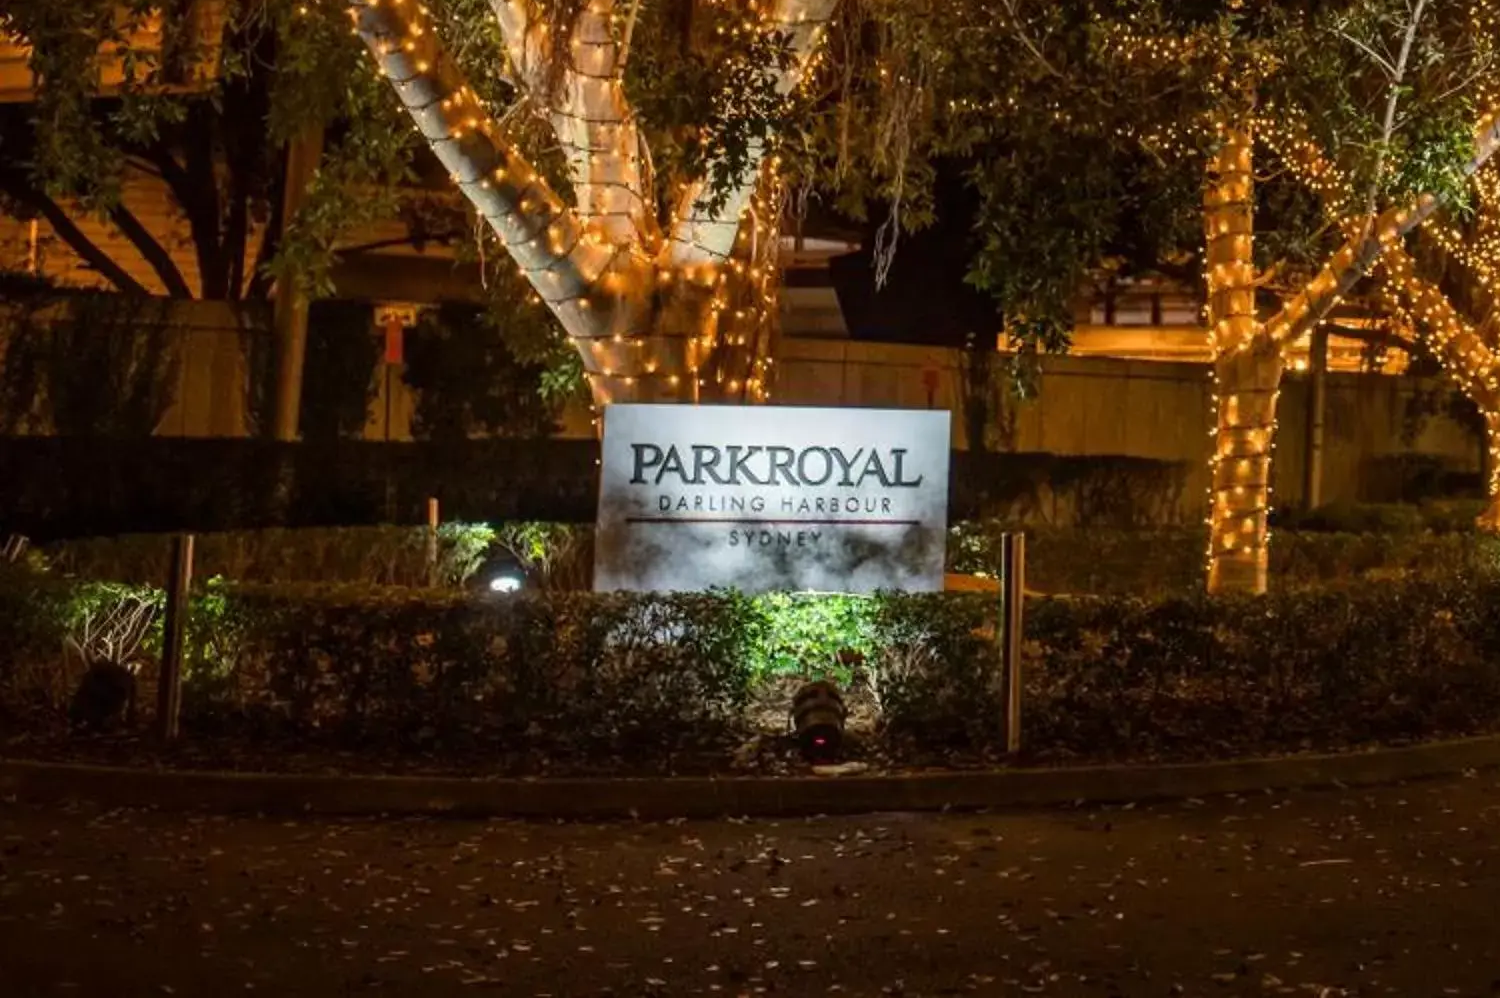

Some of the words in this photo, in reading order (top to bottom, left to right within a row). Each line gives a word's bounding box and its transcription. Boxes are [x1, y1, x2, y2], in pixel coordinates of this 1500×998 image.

[629, 442, 923, 488] PARKROYAL
[658, 495, 766, 513] DARLING
[781, 496, 892, 514] HARBOUR
[729, 530, 823, 548] SYDNEY
